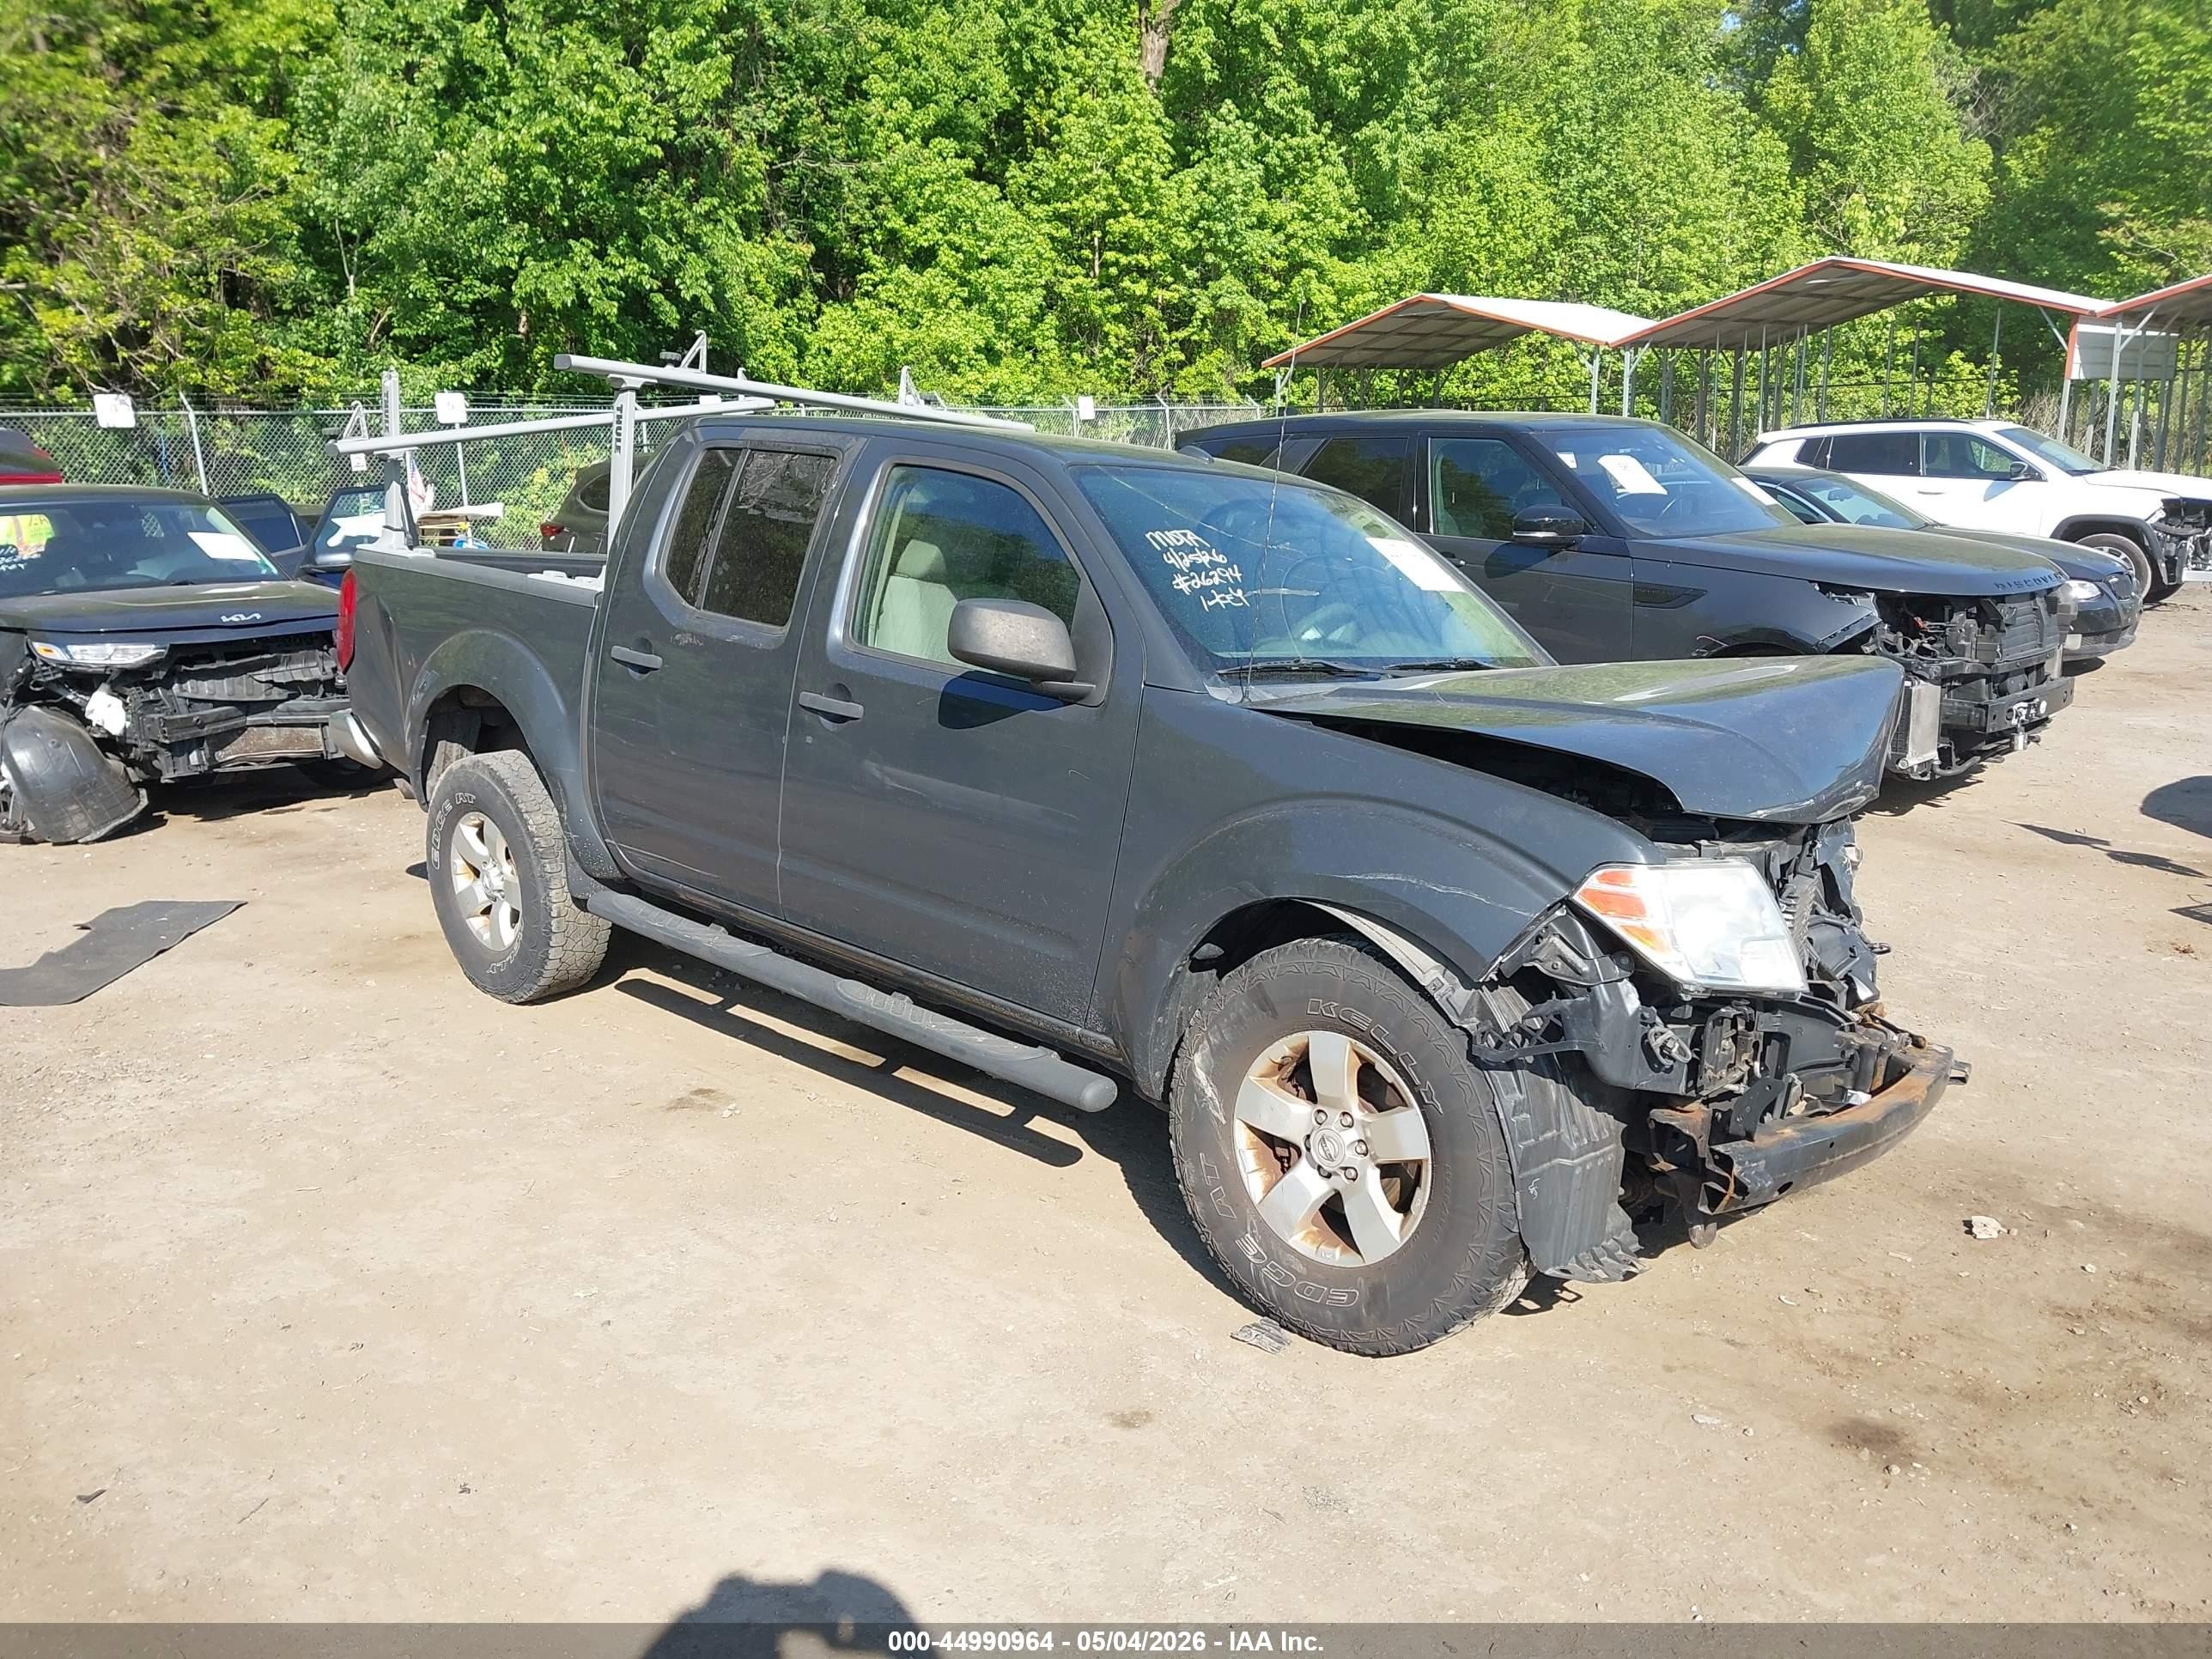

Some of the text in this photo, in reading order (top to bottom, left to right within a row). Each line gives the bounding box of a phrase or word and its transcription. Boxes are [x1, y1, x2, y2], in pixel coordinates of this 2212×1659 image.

[615, 404, 623, 454] THULE
[1172, 564, 1243, 595] #26294
[432, 799, 453, 870] EDGE
[1306, 999, 1443, 1115] KELLY
[1200, 1152, 1358, 1306] EDGE AT
